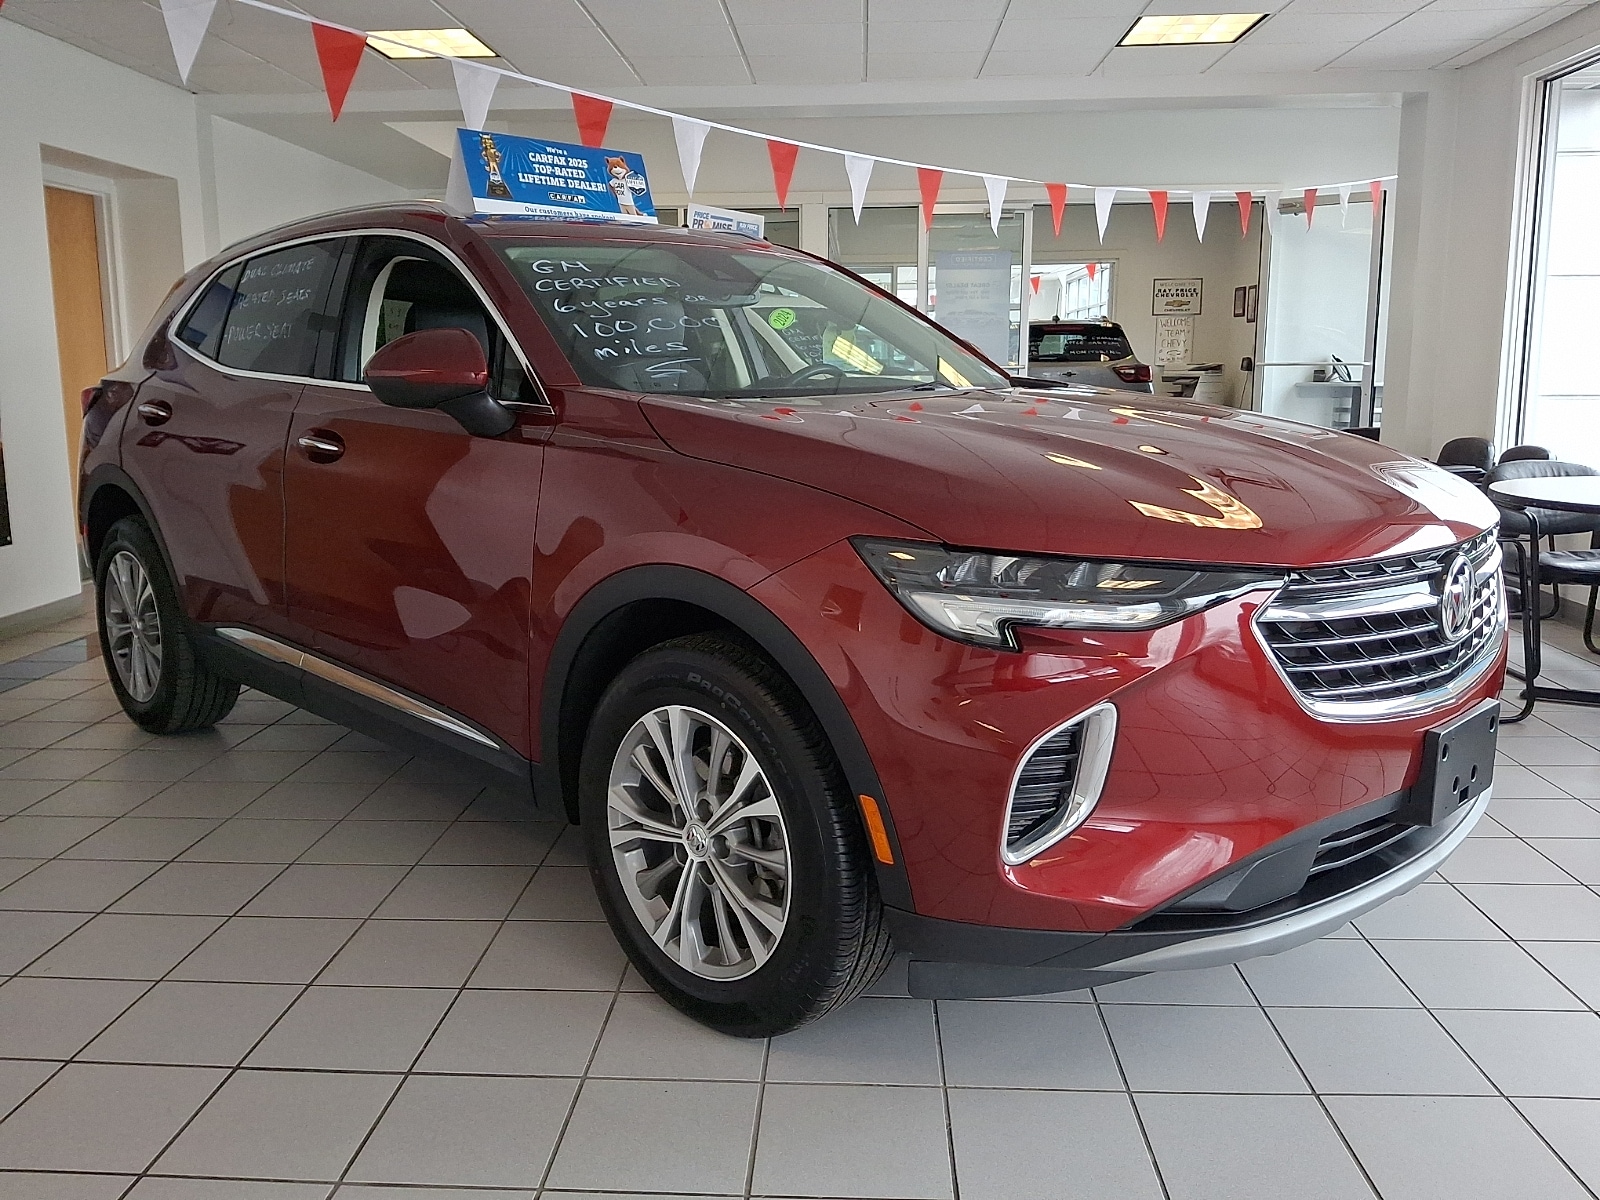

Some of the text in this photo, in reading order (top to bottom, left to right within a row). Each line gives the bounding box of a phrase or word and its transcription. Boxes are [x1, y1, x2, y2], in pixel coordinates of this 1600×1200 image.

[528, 152, 588, 168] CARFAX 2025
[532, 164, 586, 179] TOP-RATED
[518, 172, 607, 192] LIFETIME DEALER!
[524, 206, 538, 214] Our
[538, 208, 573, 218] customers
[694, 210, 710, 220] PRICE
[532, 259, 592, 274] GM
[535, 276, 681, 293] CERTIFIED
[553, 298, 577, 313] 6
[580, 296, 668, 318] years
[773, 310, 792, 326] 2024
[1160, 316, 1191, 328] WELCOME
[572, 316, 722, 338] 100,000
[1164, 329, 1186, 338] TEAM
[594, 338, 689, 361] miles
[1161, 338, 1188, 348] CHEVY
